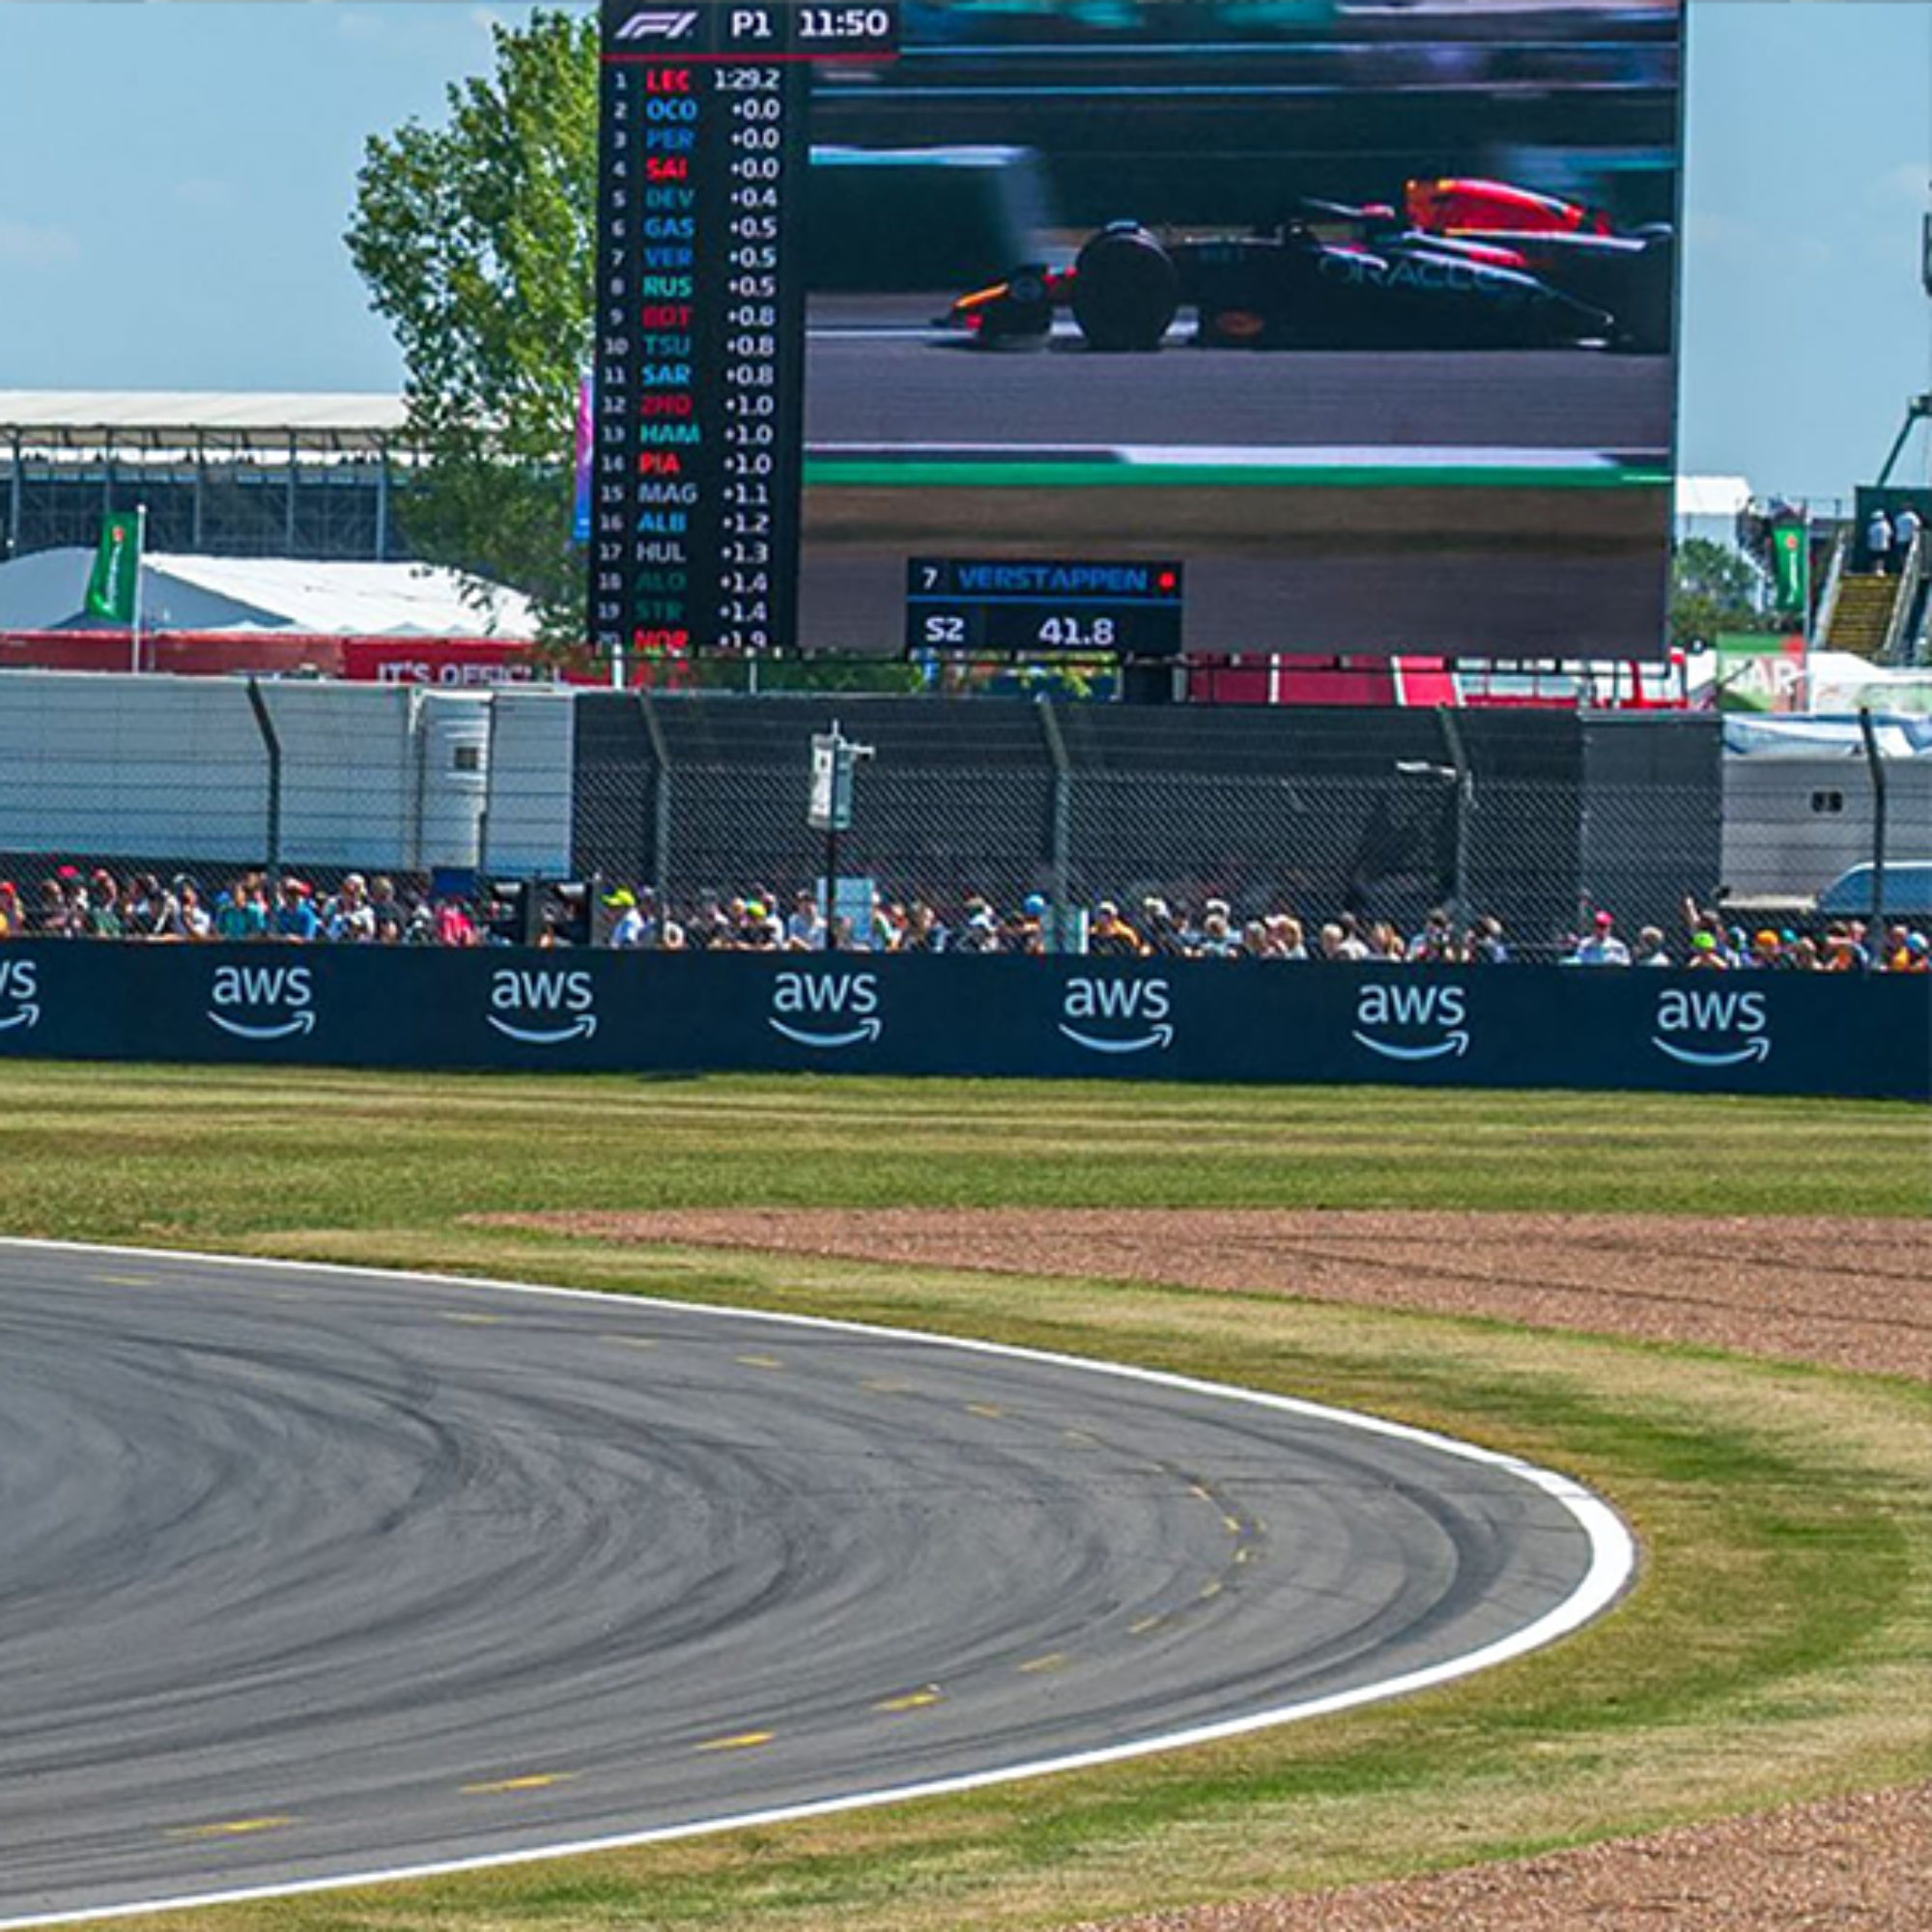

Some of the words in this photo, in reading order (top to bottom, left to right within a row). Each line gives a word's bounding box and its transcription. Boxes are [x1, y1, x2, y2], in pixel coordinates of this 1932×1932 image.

[732, 10, 772, 37] P1
[798, 10, 890, 37] 11:50
[646, 70, 689, 92] LEC
[715, 68, 781, 91] 1:29.2
[646, 98, 697, 121] OCO
[646, 128, 696, 150] PER
[646, 157, 687, 179] SAI
[645, 186, 695, 210] DEV
[643, 217, 695, 239] GAS
[644, 246, 693, 267] VER
[642, 275, 693, 298] RUS
[605, 337, 628, 355] 10
[643, 334, 692, 356] TSU
[605, 366, 625, 384] 11
[642, 363, 692, 385] SAR
[604, 395, 625, 413] 12
[603, 425, 624, 442] 13
[639, 424, 700, 444] HAM
[602, 455, 624, 472] 14
[639, 452, 679, 473] PIA
[601, 485, 623, 502] 15
[638, 482, 697, 504] MAG
[600, 514, 623, 531] 16
[637, 512, 687, 532] ALB
[600, 543, 622, 561] 17
[636, 541, 686, 563] HUL
[599, 572, 622, 590] 18
[922, 566, 939, 590] 7
[957, 564, 1149, 591] VERSTAPPEN
[599, 602, 620, 619] 19
[924, 615, 965, 643] S2
[1037, 616, 1115, 646] 41.8
[376, 660, 431, 685] IT'S
[212, 966, 312, 1007] aws
[491, 969, 592, 1010] aws
[773, 971, 877, 1013] aws
[1064, 977, 1170, 1020] aws
[1357, 983, 1466, 1027] aws
[1656, 989, 1767, 1033] aws
